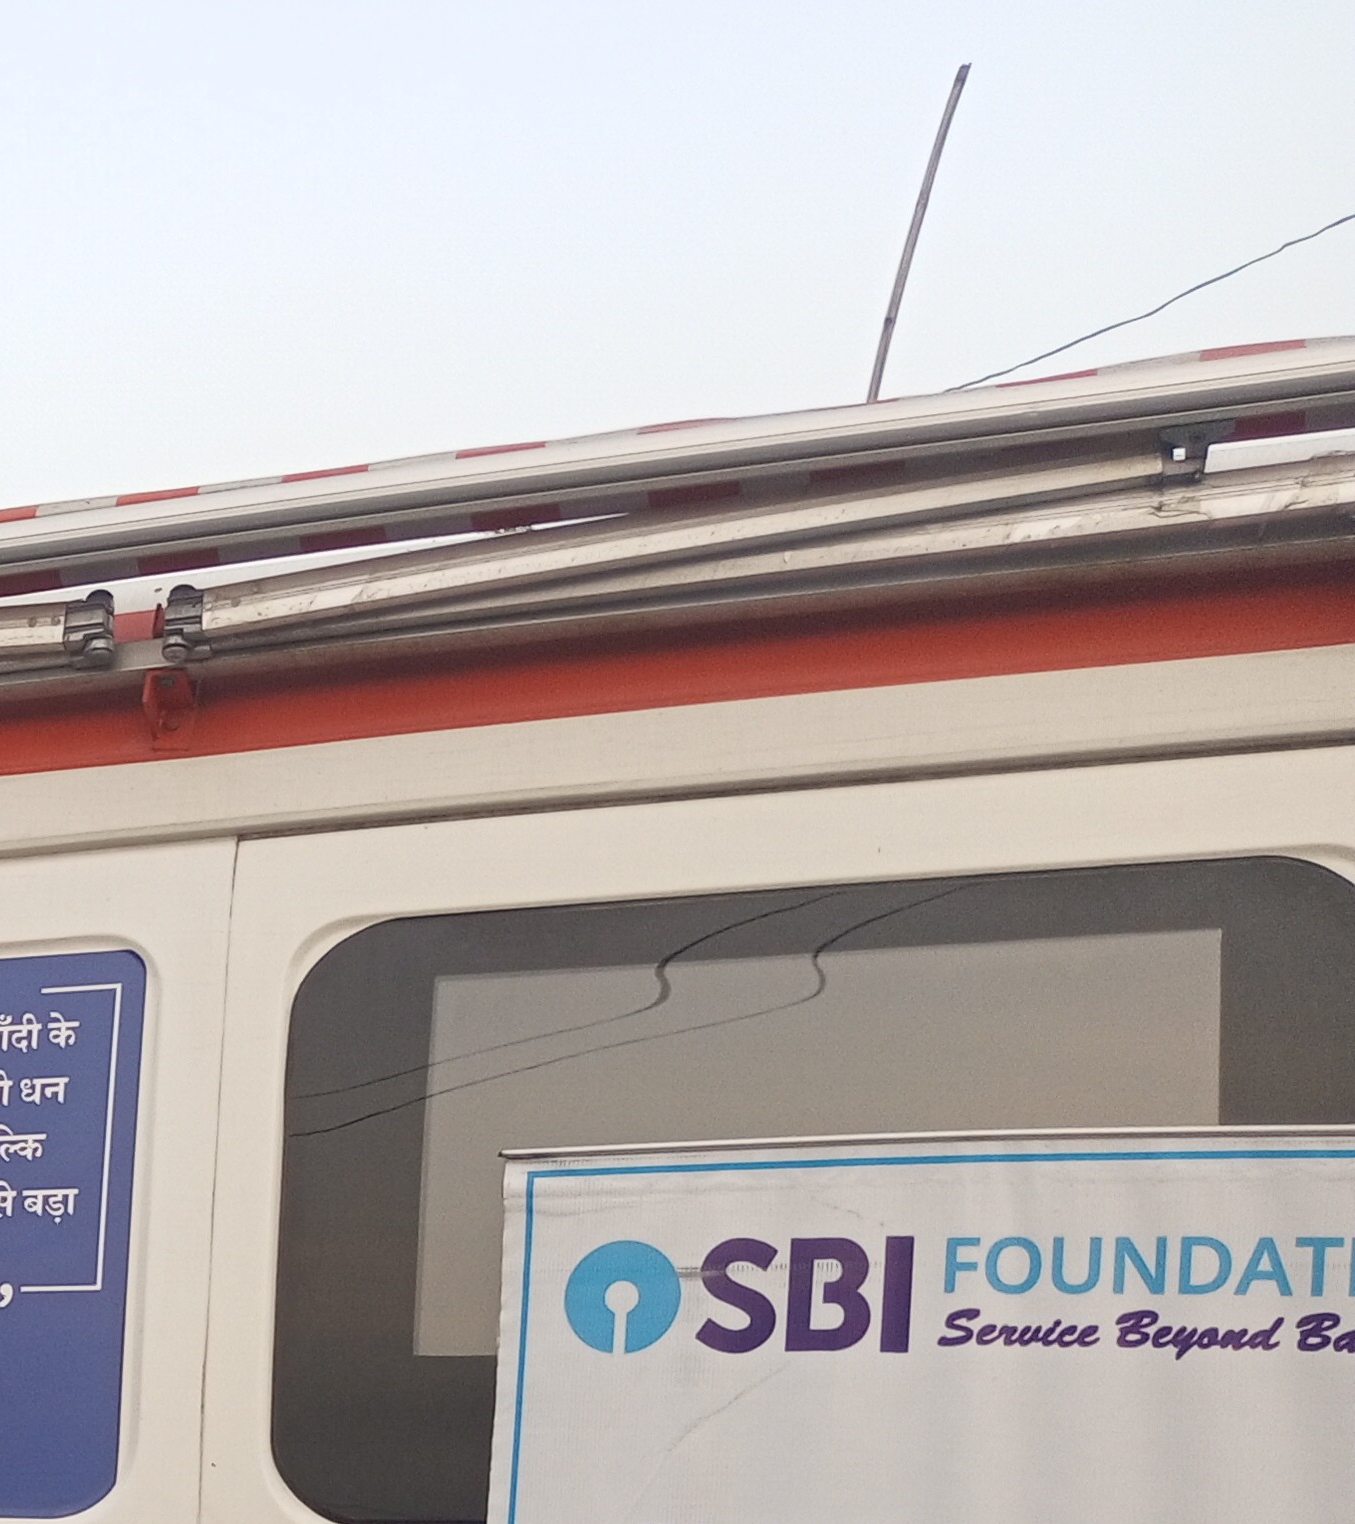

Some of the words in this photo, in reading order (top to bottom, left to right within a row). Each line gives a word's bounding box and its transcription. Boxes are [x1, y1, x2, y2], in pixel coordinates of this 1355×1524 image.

[48, 1011, 81, 1049] के
[19, 1076, 70, 1105] धन
[22, 1188, 80, 1225] बड़ा
[695, 1235, 916, 1354] SBI
[937, 1308, 1101, 1349] Service
[1115, 1311, 1285, 1363] Beyond
